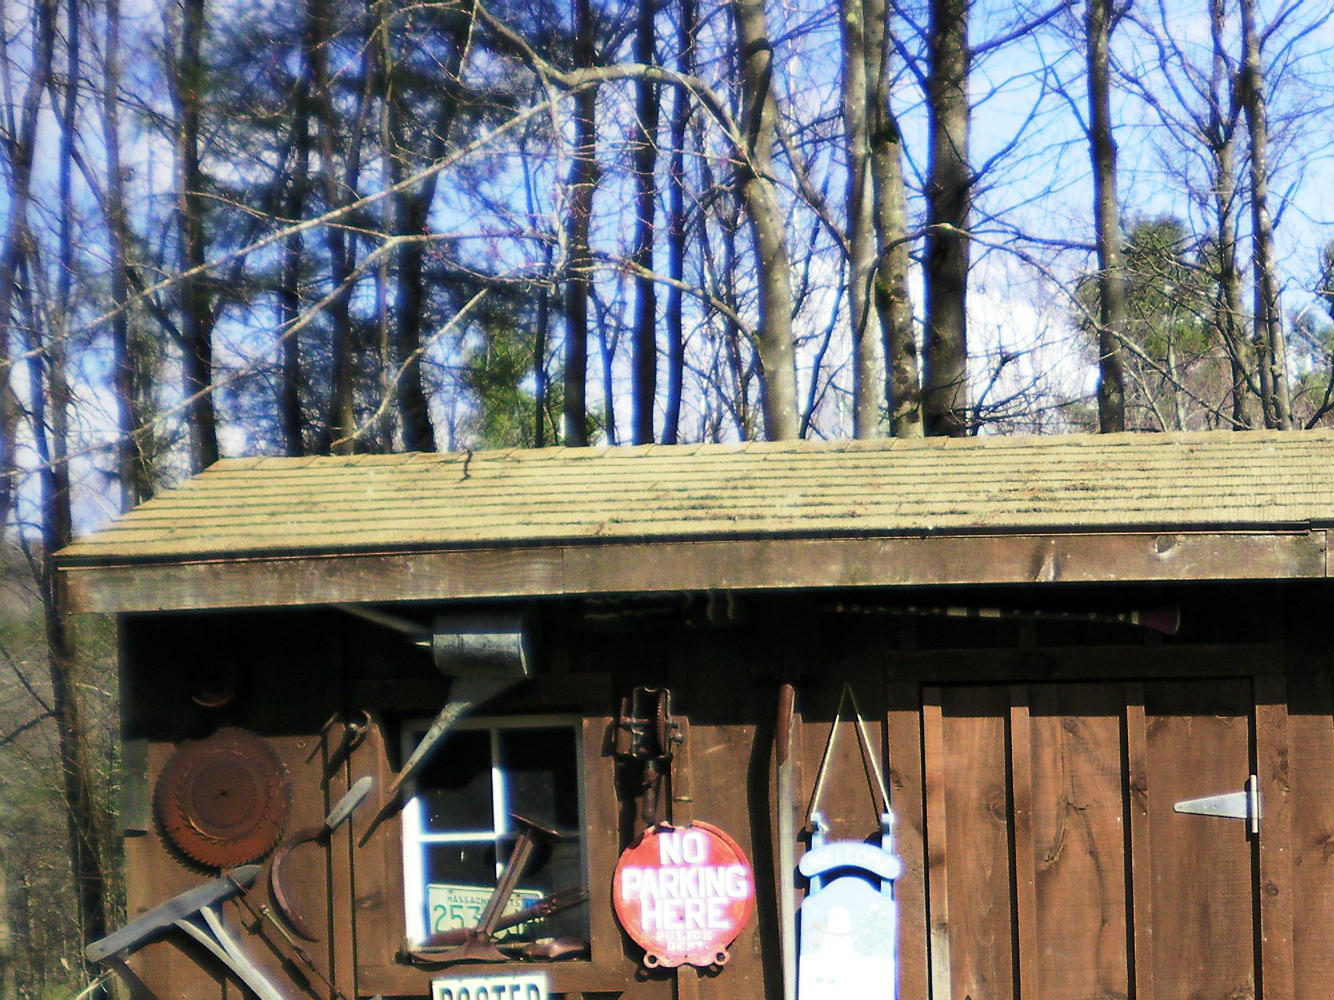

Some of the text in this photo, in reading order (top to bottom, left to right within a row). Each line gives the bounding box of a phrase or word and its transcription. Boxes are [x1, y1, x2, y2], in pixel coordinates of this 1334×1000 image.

[658, 831, 706, 865] NO
[620, 865, 749, 900] PARKING
[640, 897, 732, 930] HERE
[655, 931, 713, 942] POLICE
